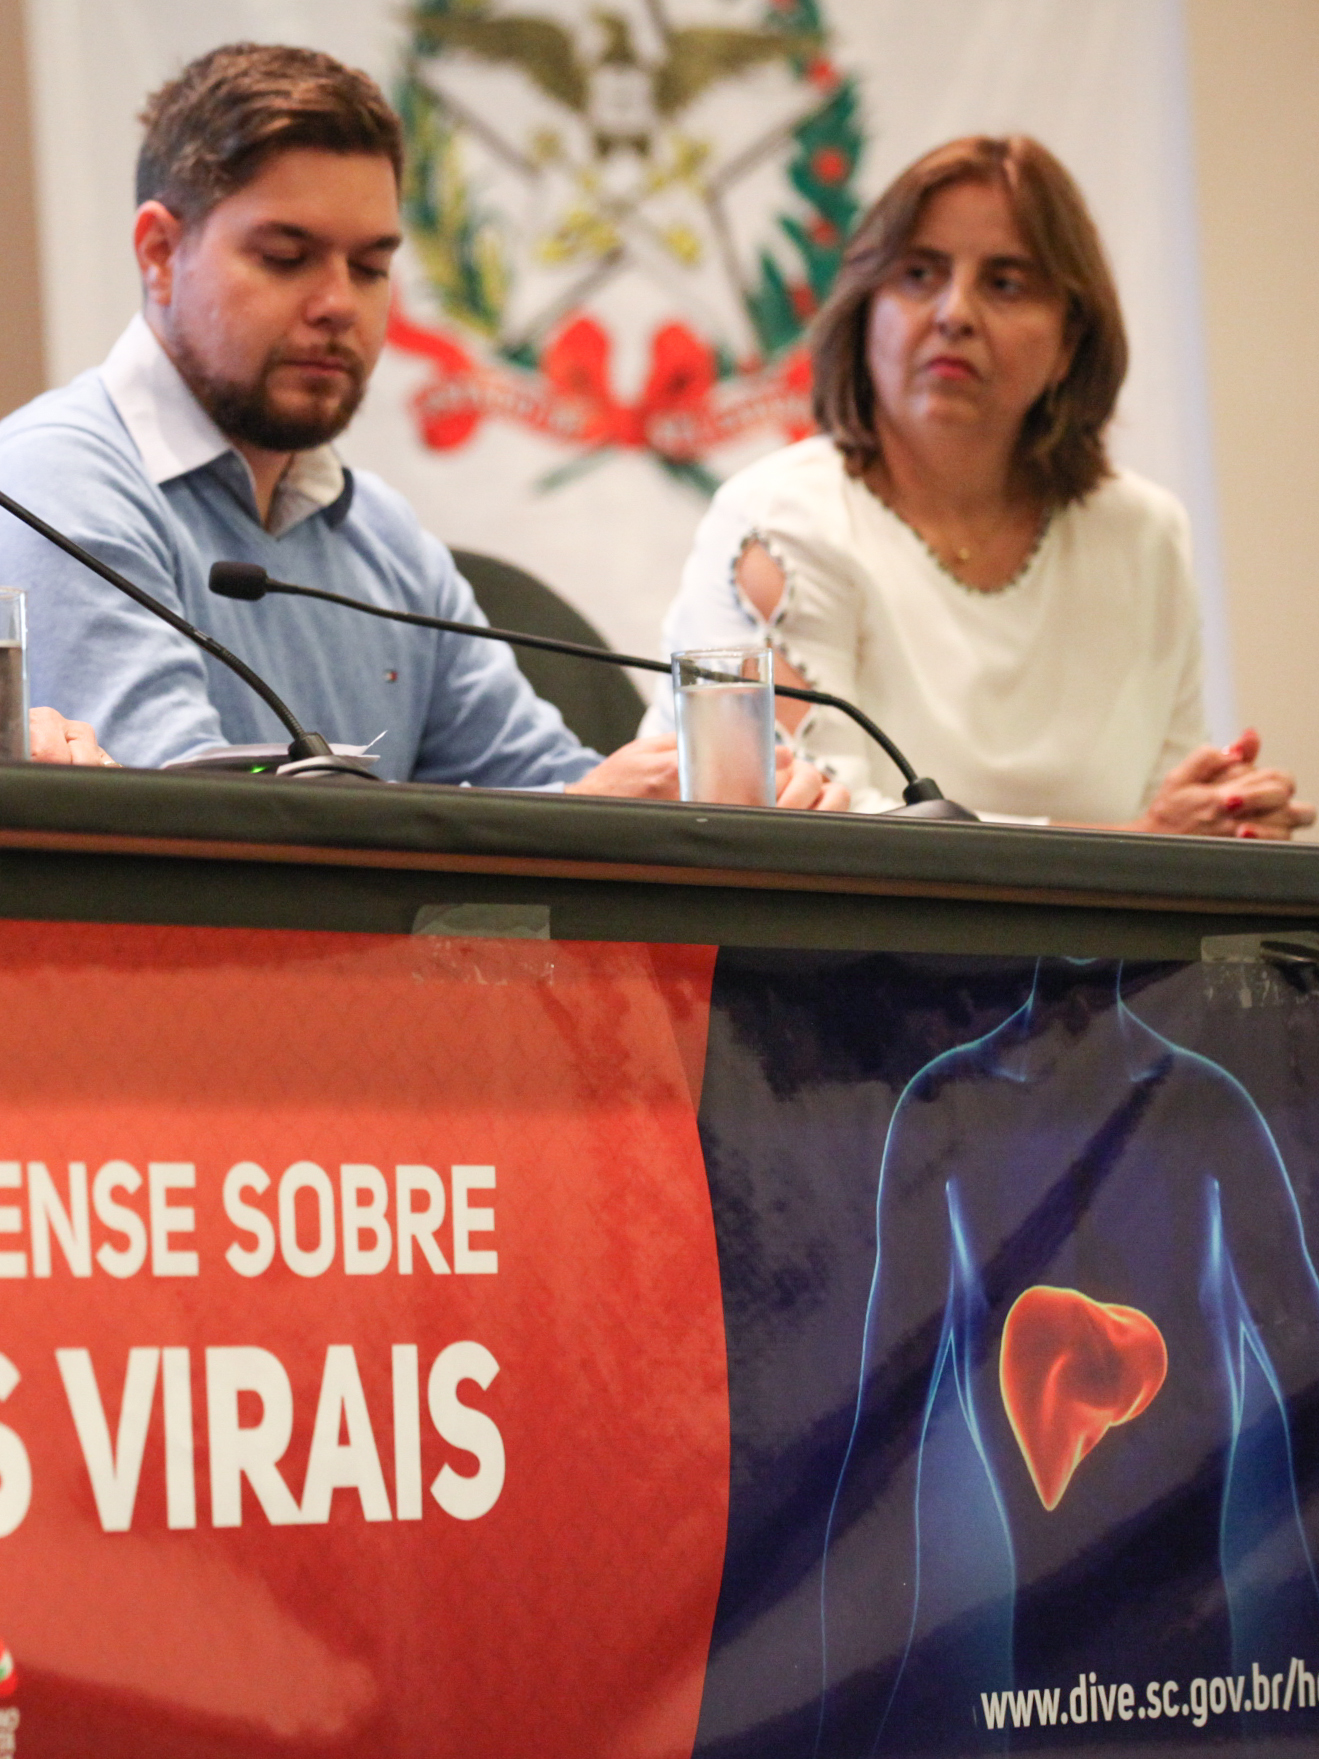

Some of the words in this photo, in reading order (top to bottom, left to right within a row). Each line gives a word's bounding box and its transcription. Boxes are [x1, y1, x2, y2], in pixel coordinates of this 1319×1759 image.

[222, 1160, 499, 1278] SOBRE
[54, 1340, 506, 1532] VIRAIS
[980, 1657, 1319, 1730] www.dive.sc.gov.br/h
